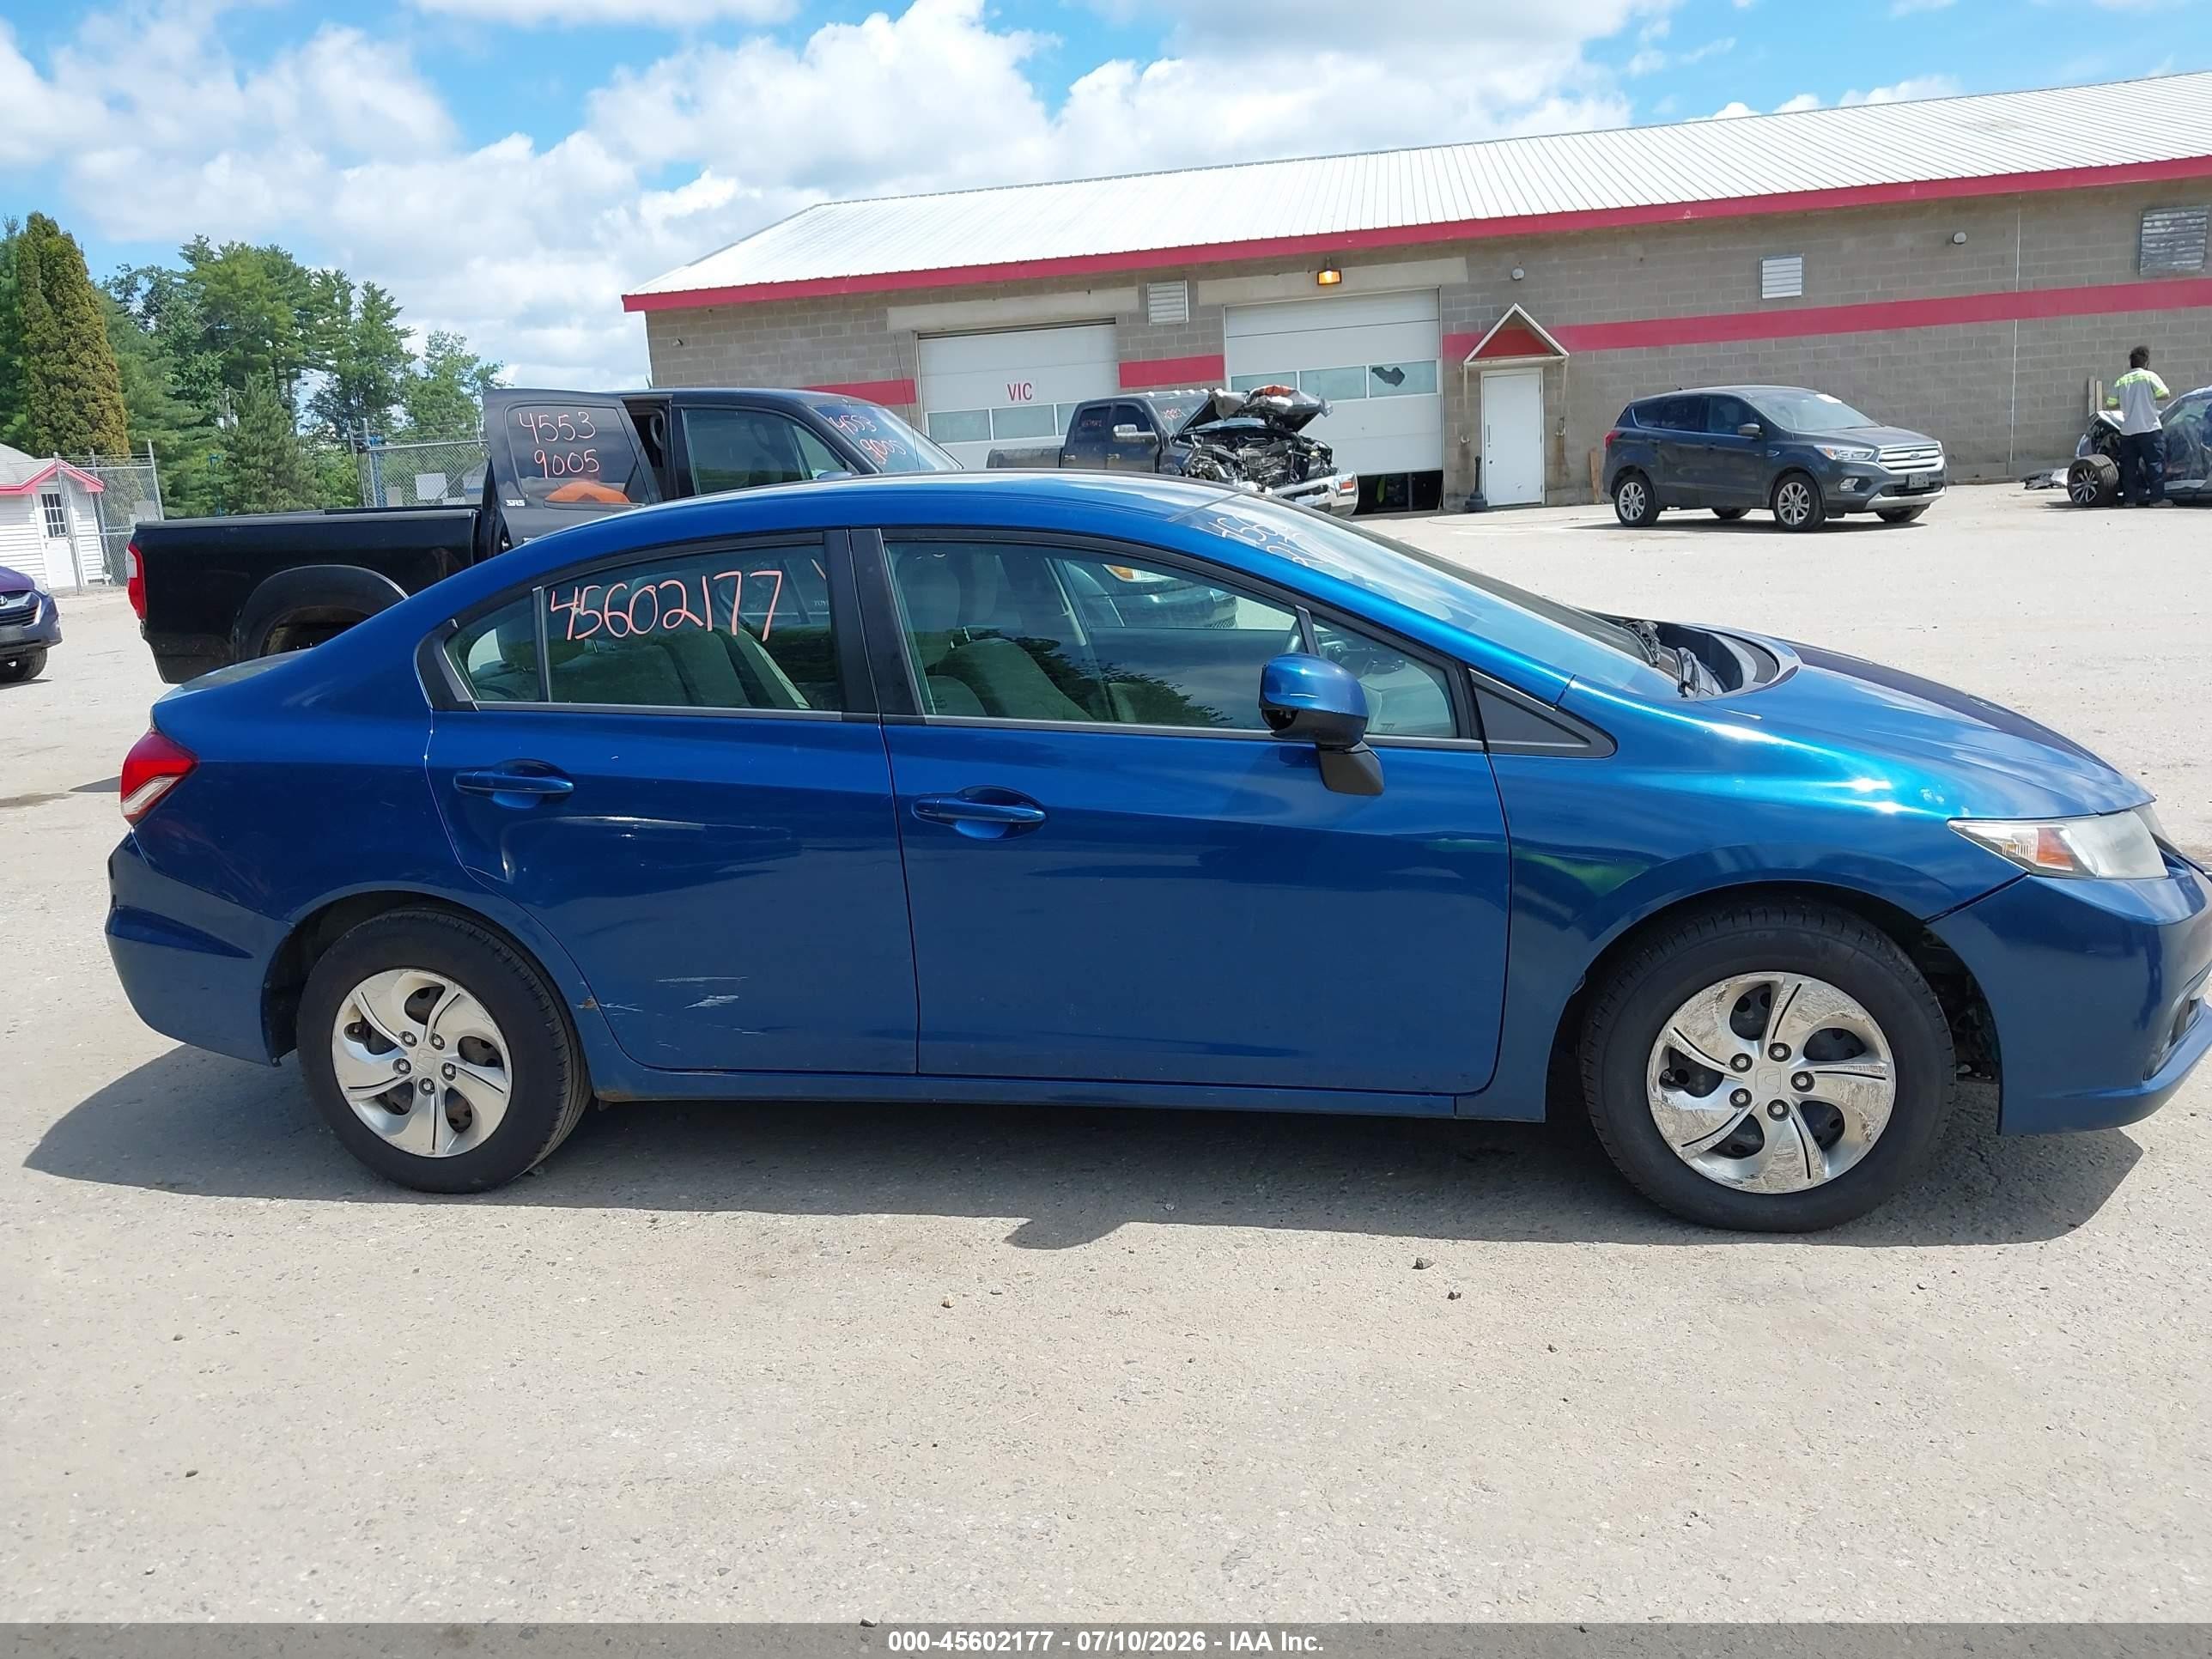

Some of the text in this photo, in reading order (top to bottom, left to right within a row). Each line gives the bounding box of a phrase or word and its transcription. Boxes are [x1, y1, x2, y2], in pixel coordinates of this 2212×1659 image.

[1006, 382, 1033, 402] VIC
[518, 411, 596, 445] 4553
[829, 415, 878, 435] 4553
[533, 448, 600, 480] 9005
[860, 438, 907, 462] 9005
[550, 570, 782, 642] 45602177
